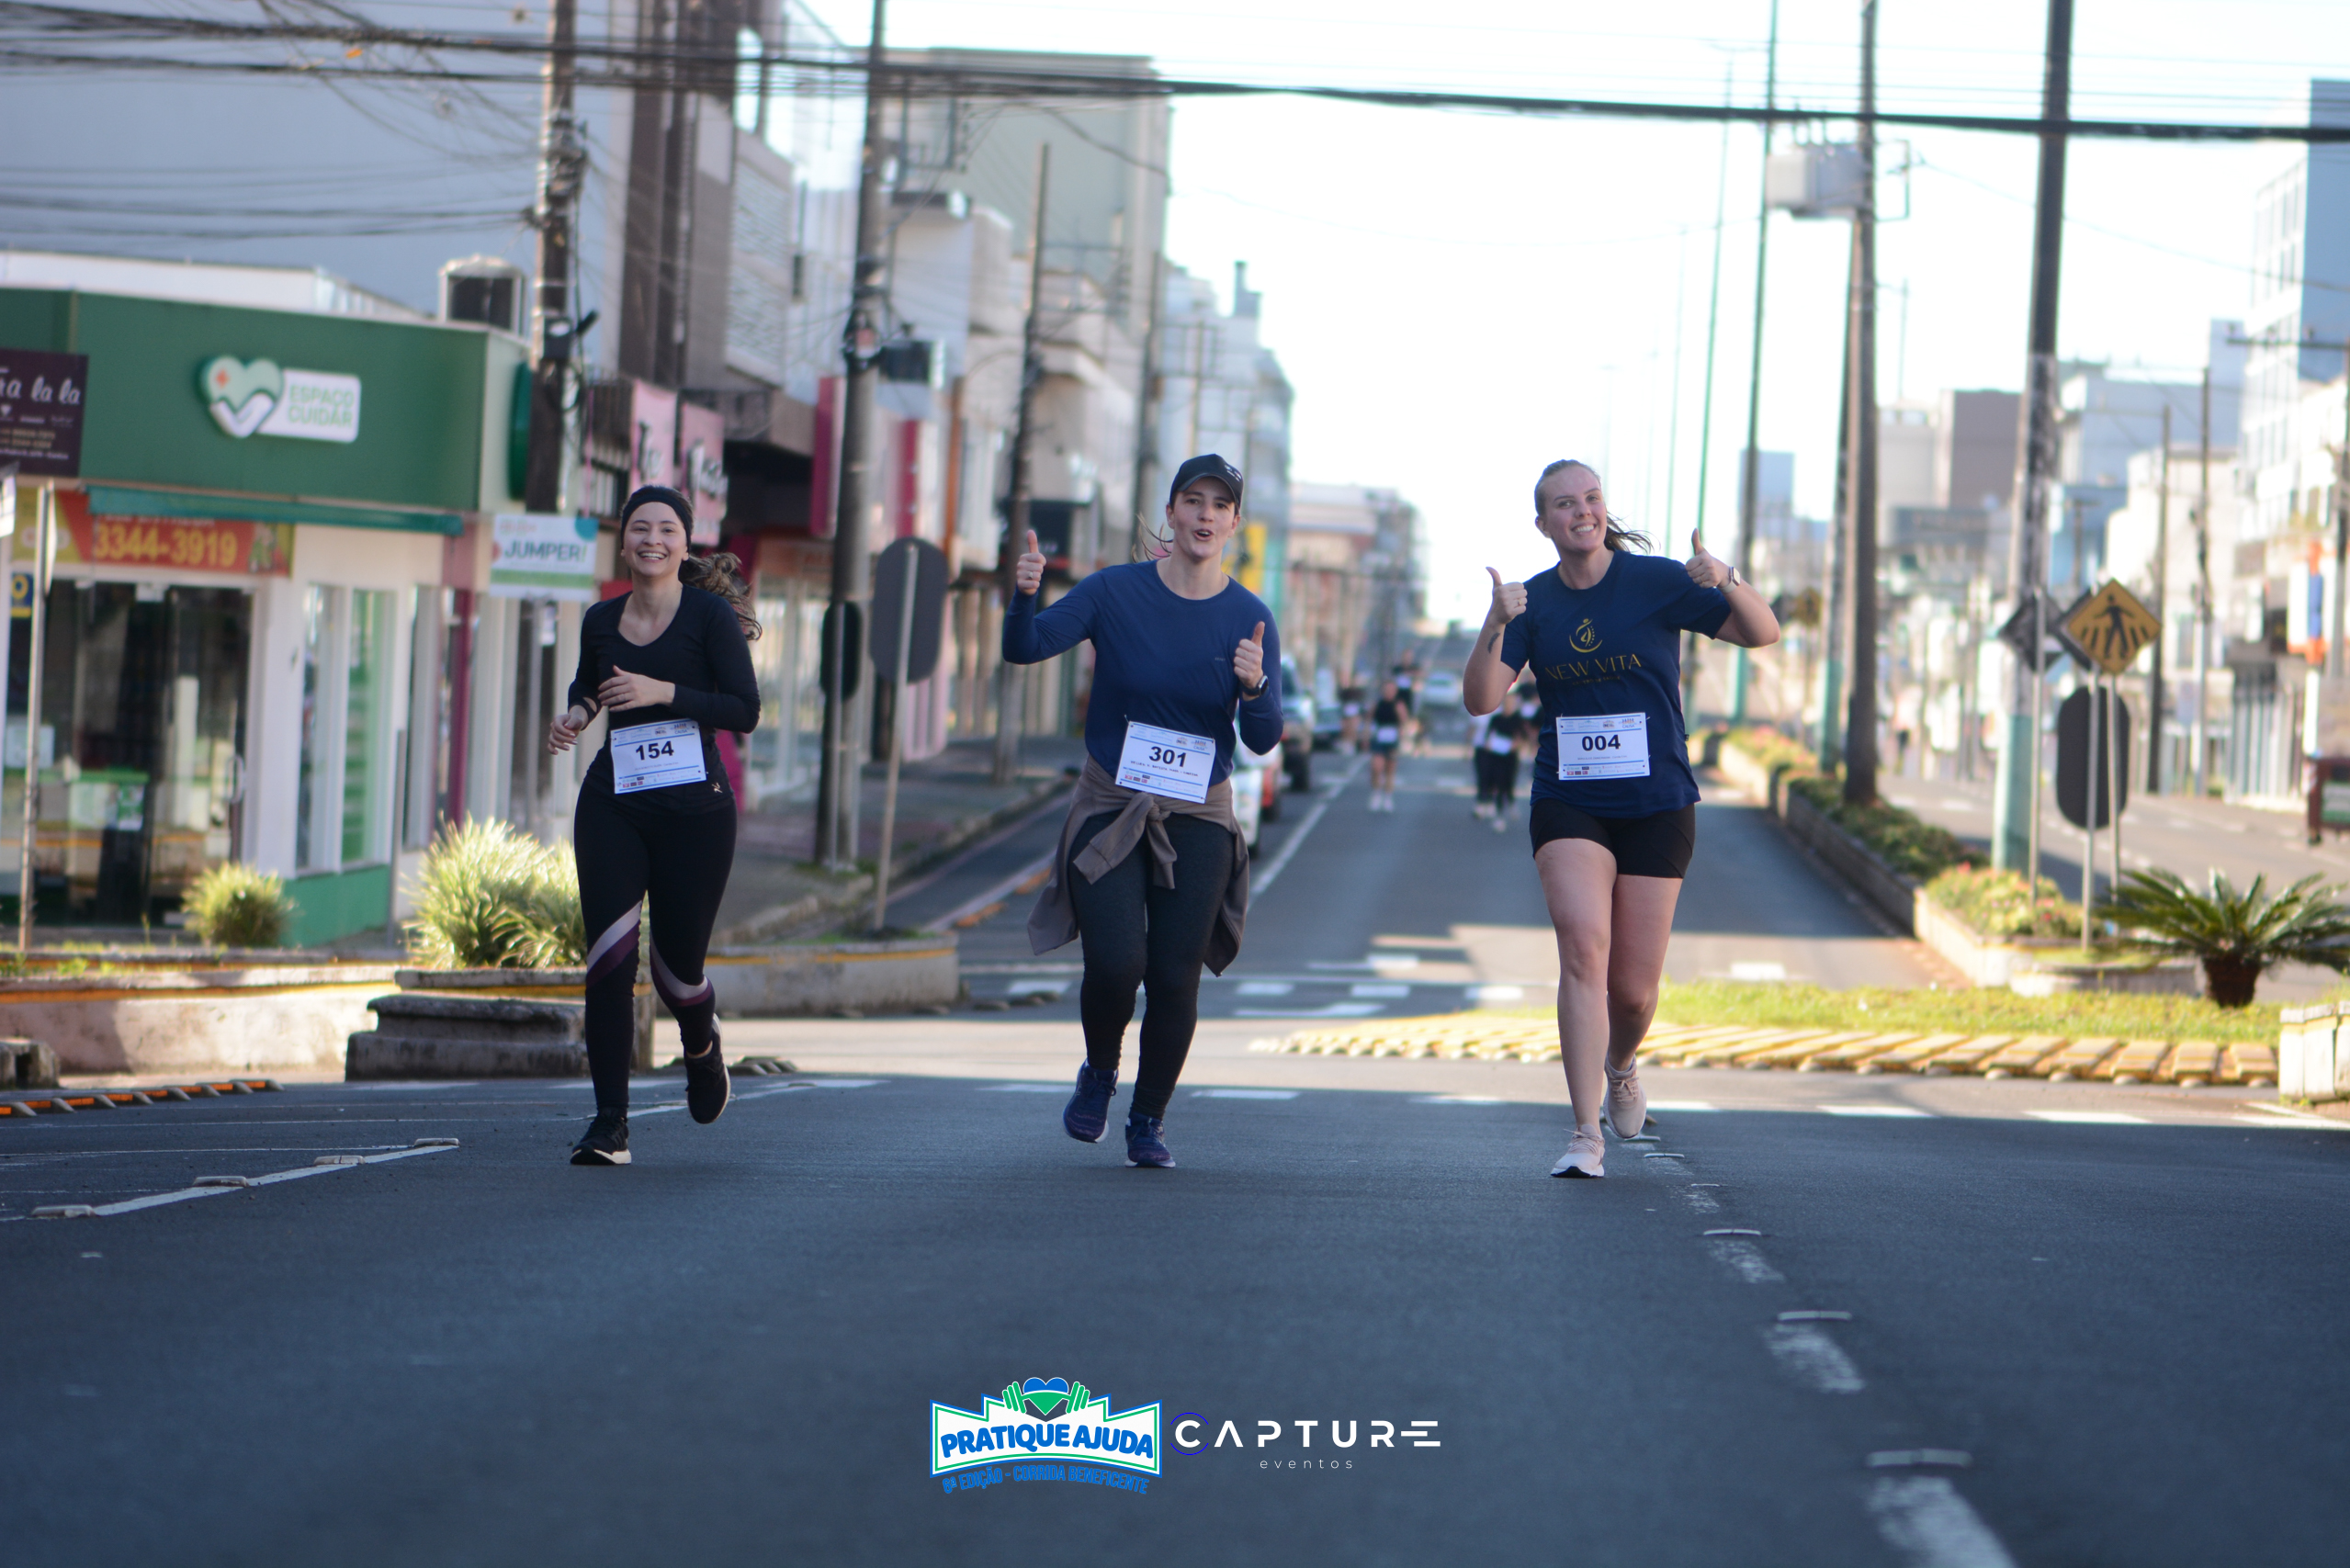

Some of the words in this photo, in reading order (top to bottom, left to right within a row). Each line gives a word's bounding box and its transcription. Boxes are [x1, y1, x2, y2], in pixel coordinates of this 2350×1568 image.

[31, 376, 53, 402] la
[58, 378, 81, 405] la
[288, 404, 353, 428] CUIDAR
[96, 523, 238, 568] 3344-3919
[1545, 660, 1589, 680] NEW
[1595, 653, 1642, 673] VITA
[635, 740, 674, 761] 154
[1582, 734, 1621, 751] 004
[1148, 746, 1187, 768] 301
